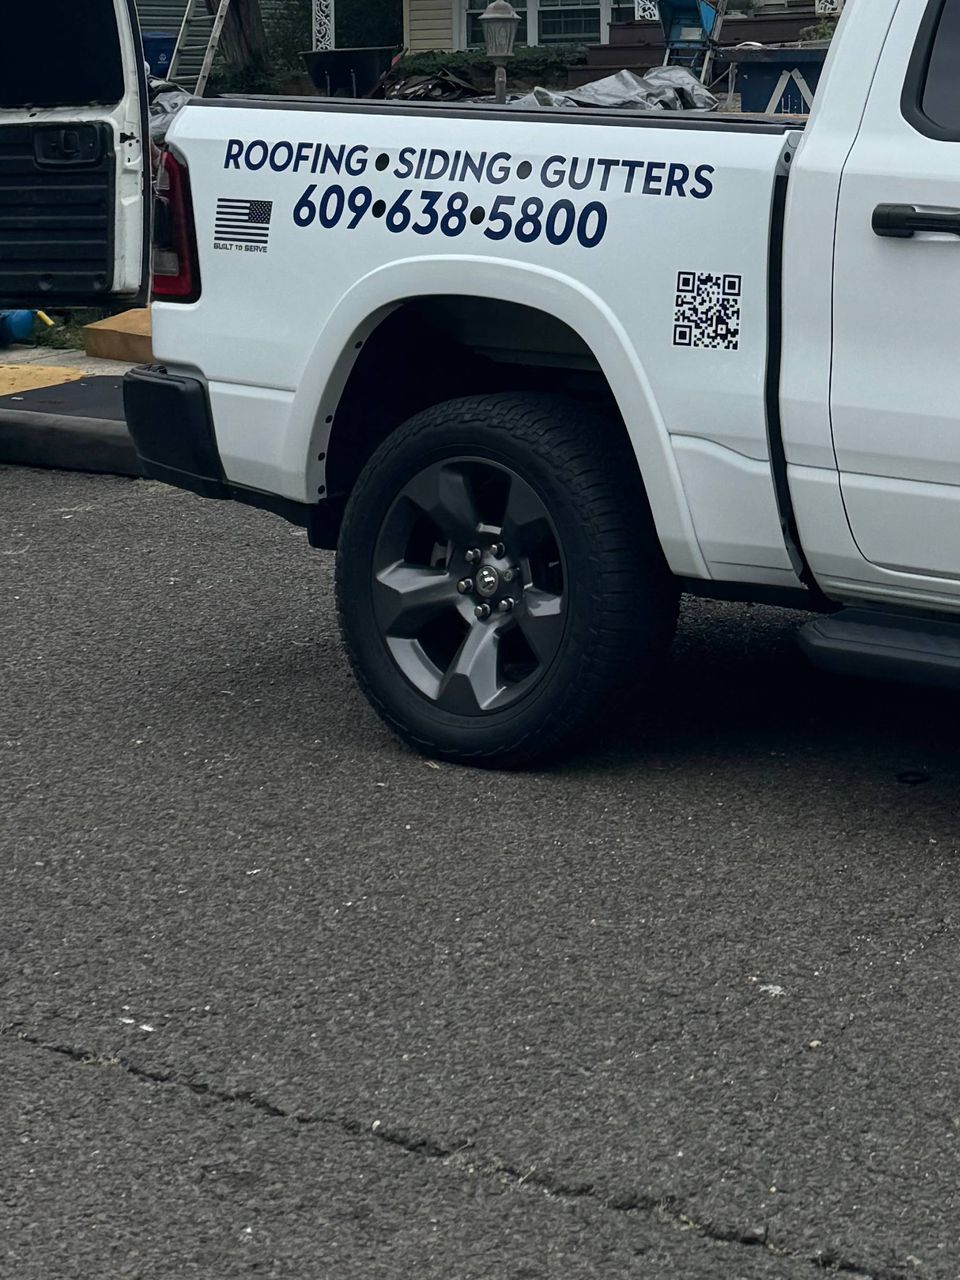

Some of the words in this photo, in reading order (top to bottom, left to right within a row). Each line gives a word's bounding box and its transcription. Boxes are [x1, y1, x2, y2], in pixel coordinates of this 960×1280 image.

[224, 139, 369, 176] ROOFING
[393, 147, 512, 184] SIDING
[540, 155, 715, 199] GUTTERS
[213, 243, 234, 251] BUILT
[244, 245, 268, 253] SERVE
